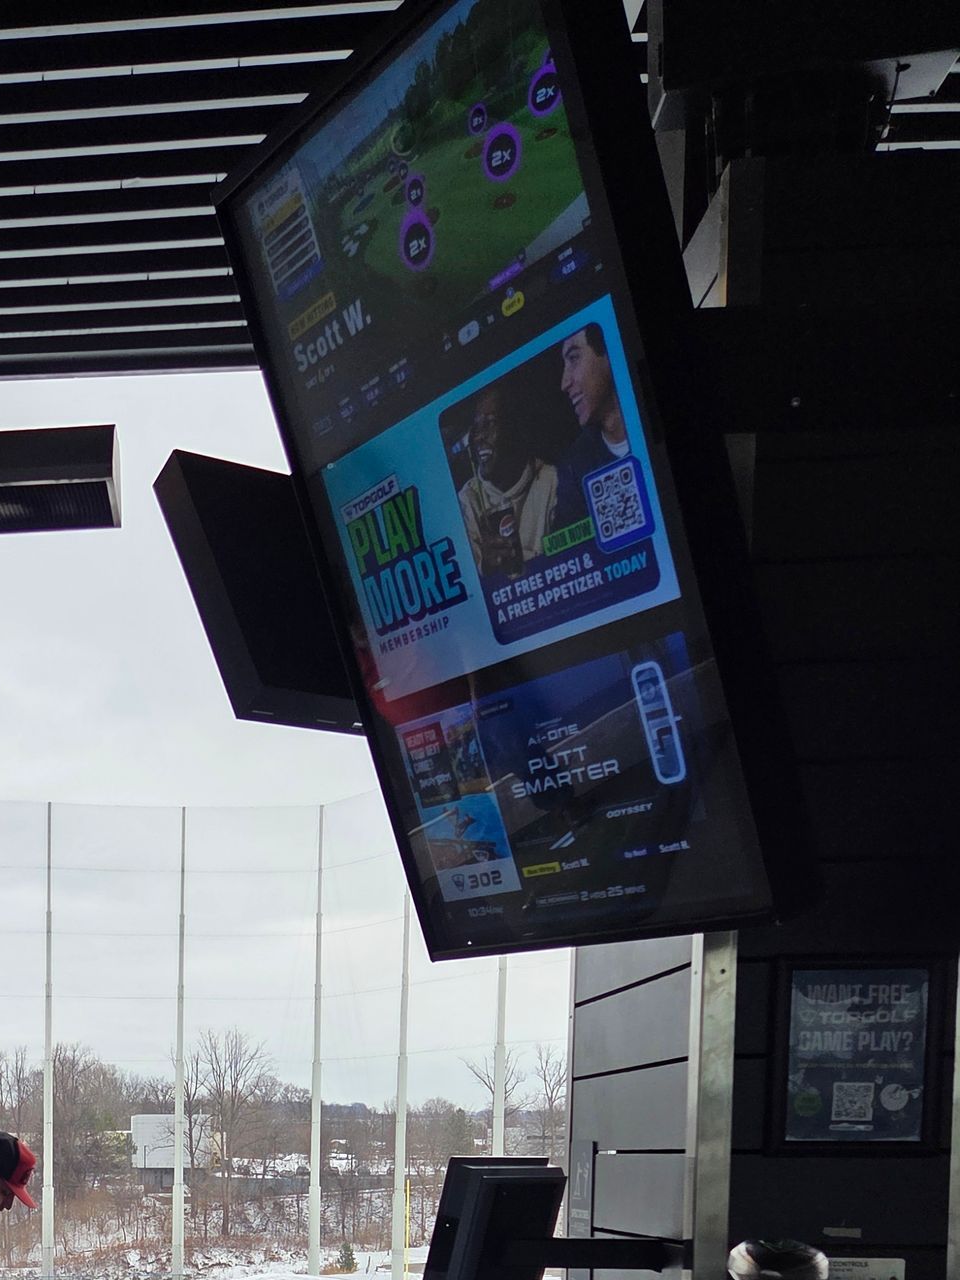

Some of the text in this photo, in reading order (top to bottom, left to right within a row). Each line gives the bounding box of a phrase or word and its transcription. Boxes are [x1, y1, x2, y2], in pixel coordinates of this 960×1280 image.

[536, 85, 556, 103] 2x
[491, 149, 512, 168] 2x
[409, 236, 427, 257] 2x
[293, 319, 343, 373] Scott
[342, 298, 372, 337] W.
[352, 480, 395, 515] TOPGOLF
[347, 487, 423, 575] PLAY
[363, 538, 464, 630] MORE
[491, 552, 594, 606] GET FREE PEPSI &
[496, 609, 507, 625] A
[507, 597, 537, 622] FREE
[537, 572, 604, 609] APPETIZER
[603, 551, 649, 582] TODAY
[379, 615, 450, 655] MEMBERSHIP
[528, 745, 587, 775] PUTT
[511, 759, 621, 799] SMARTER
[606, 802, 653, 819] ODYSSEY
[468, 870, 504, 890] 302
[580, 890, 589, 902] 2
[607, 885, 624, 898] 25
[807, 984, 910, 1005] WANT FREE
[819, 1010, 919, 1025] TOPGOLF
[798, 1031, 913, 1052] GAME PLAY?
